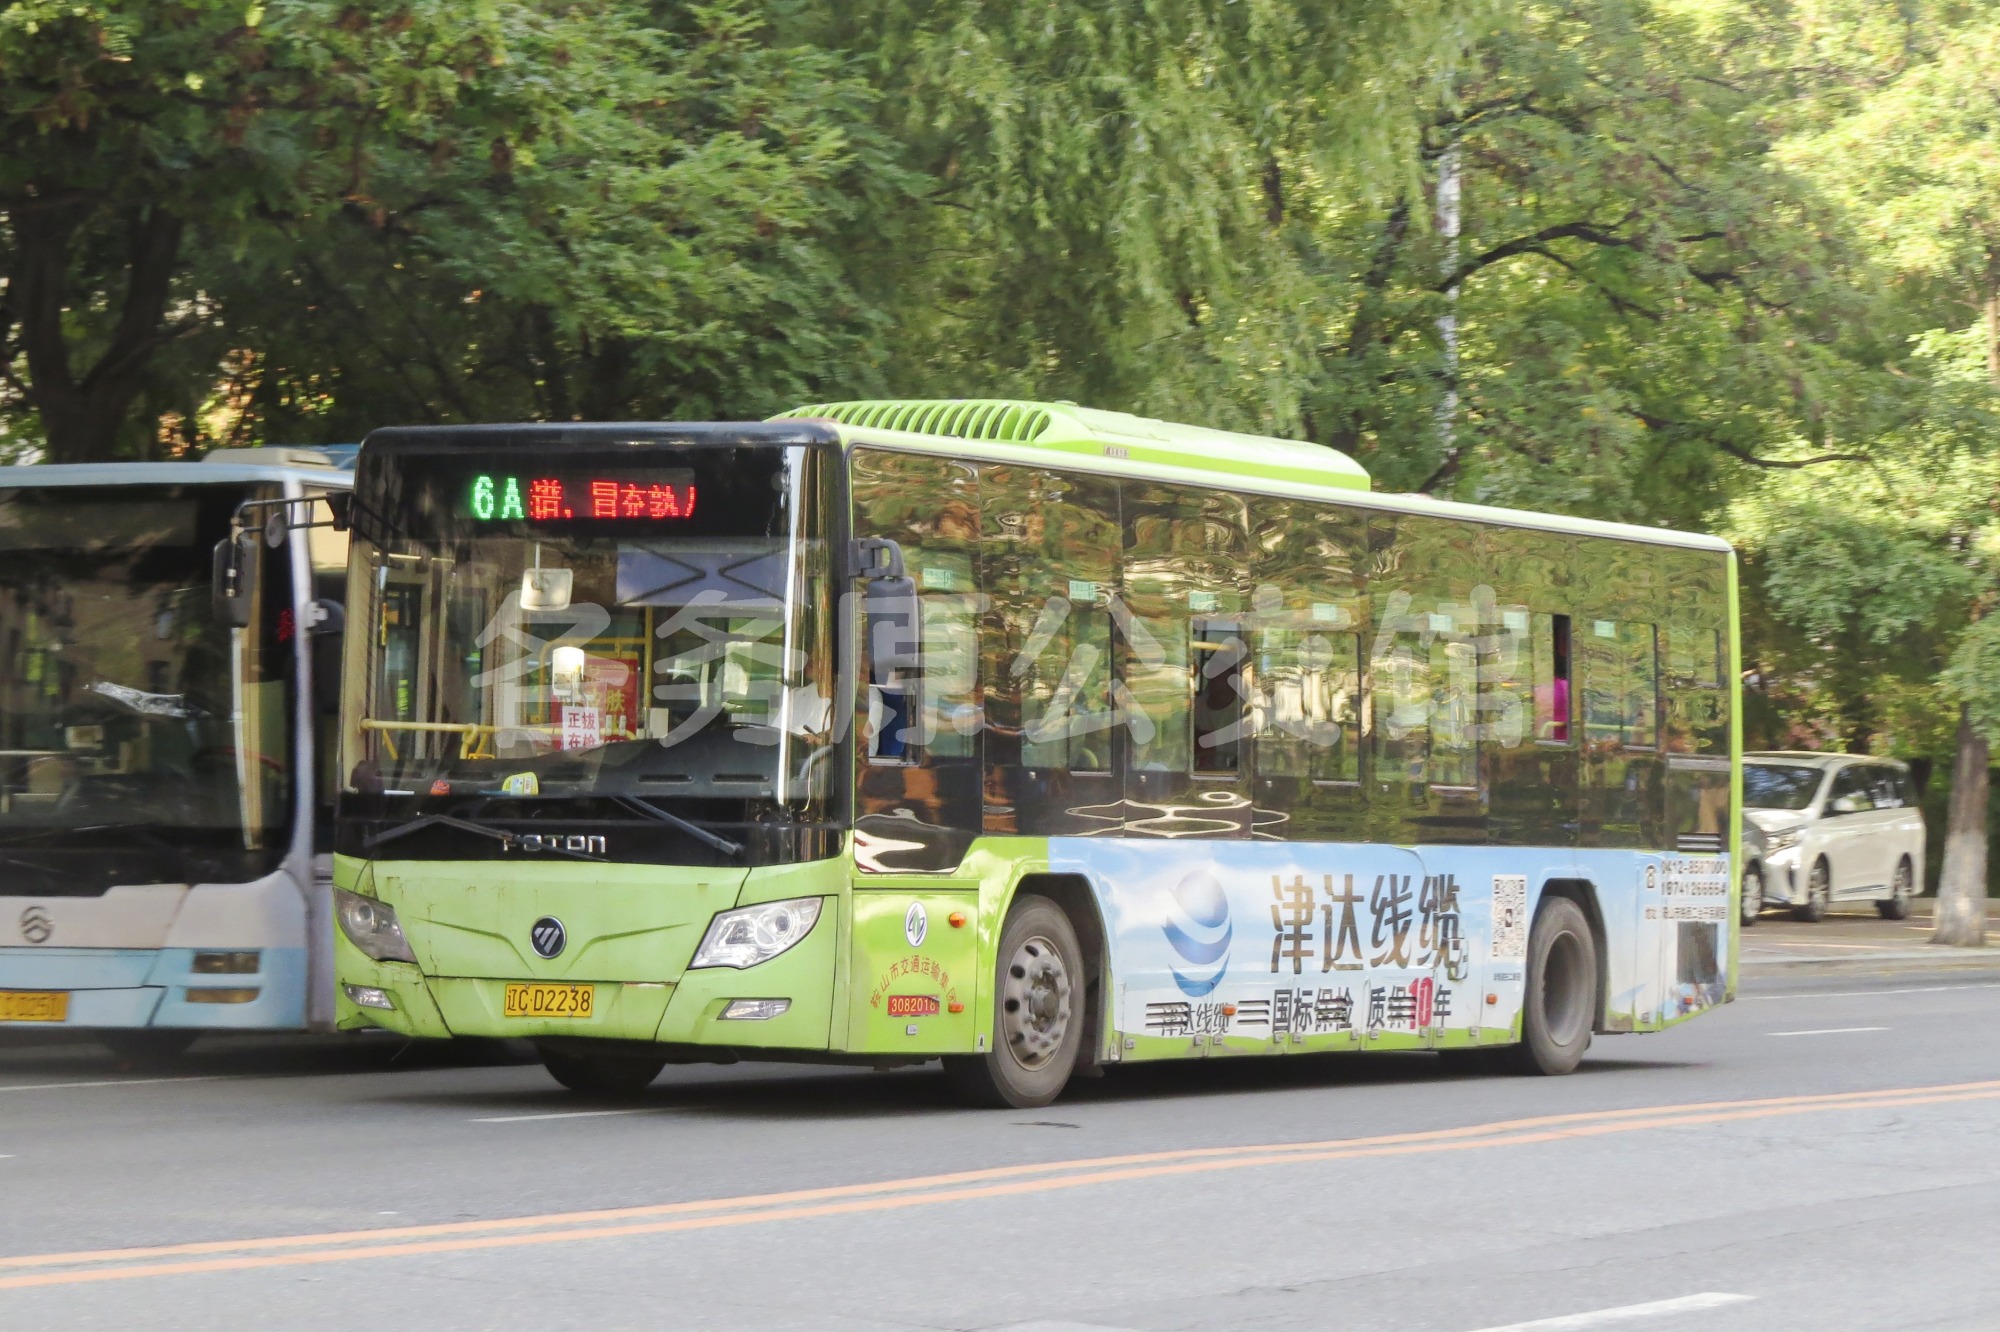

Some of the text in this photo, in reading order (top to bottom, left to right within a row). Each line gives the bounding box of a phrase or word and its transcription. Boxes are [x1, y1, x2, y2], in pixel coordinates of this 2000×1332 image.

[473, 476, 525, 520] 6A
[1270, 872, 1461, 976] 津达线缆
